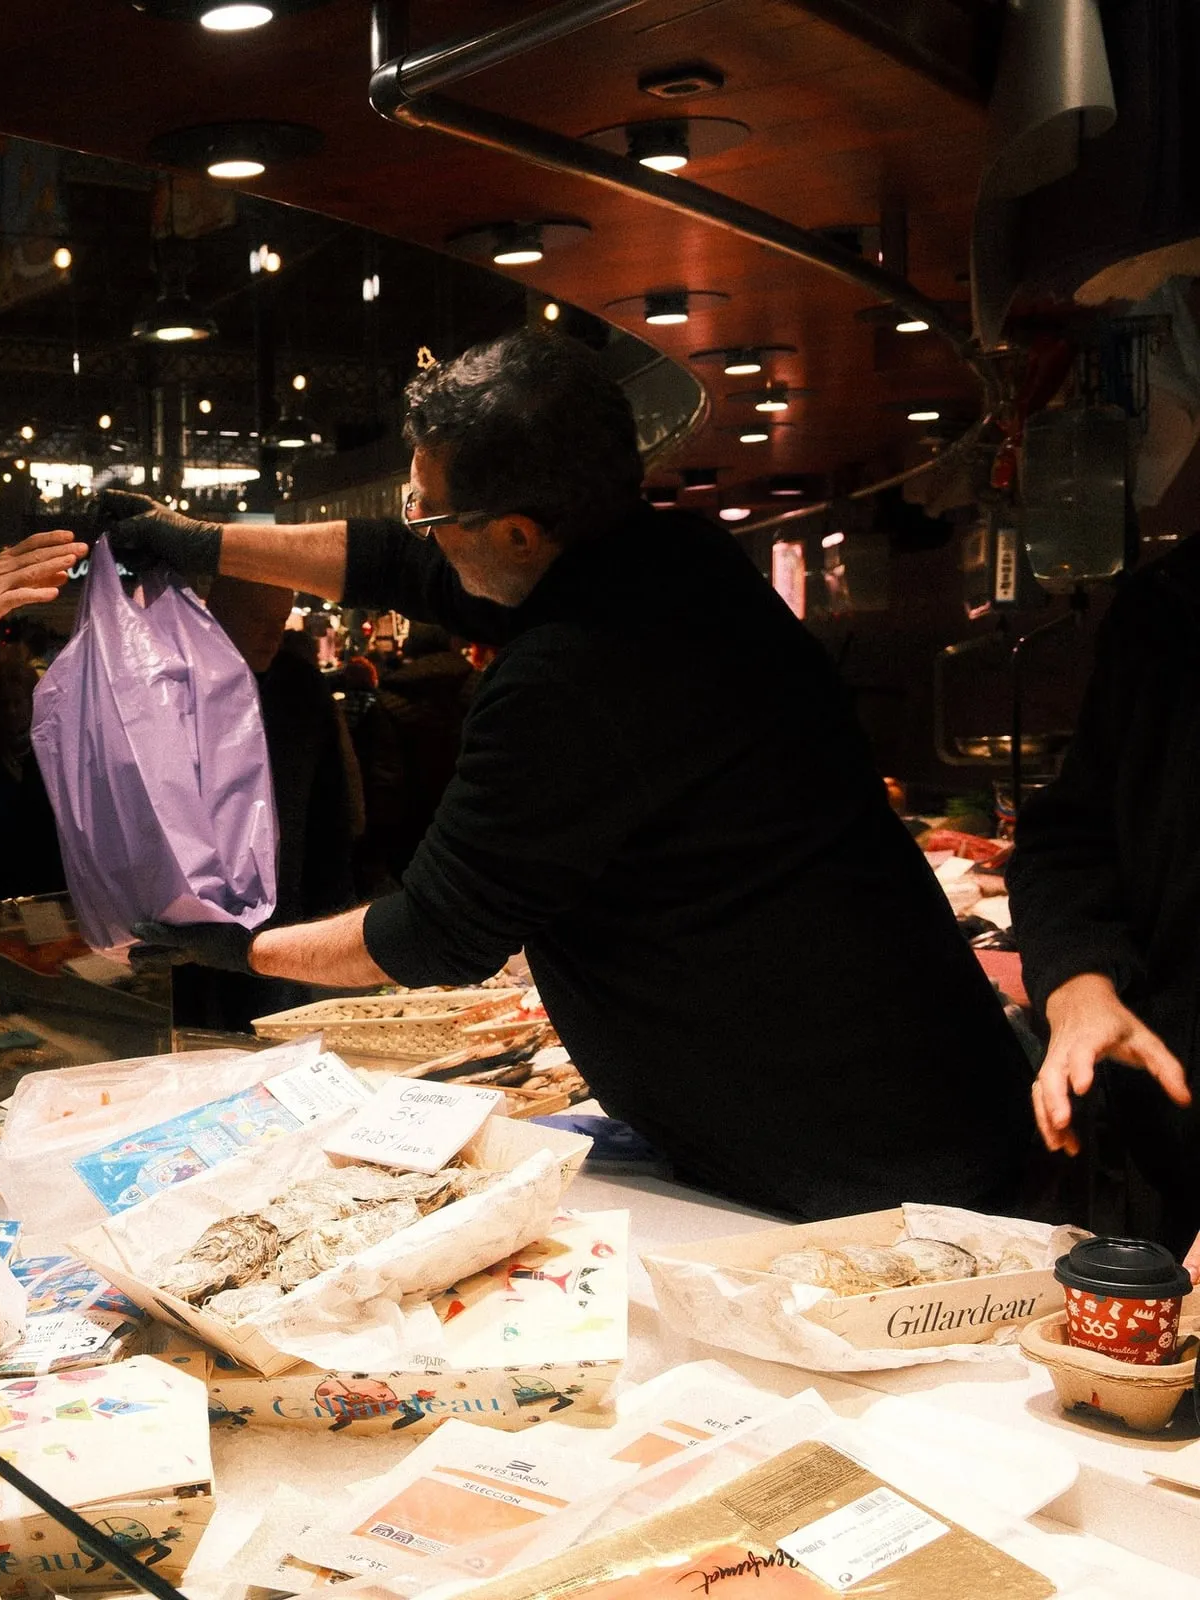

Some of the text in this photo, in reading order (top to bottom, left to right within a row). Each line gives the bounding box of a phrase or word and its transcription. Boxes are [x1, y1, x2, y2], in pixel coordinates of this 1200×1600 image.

[886, 1293, 1038, 1339] Gillardeau
[1080, 1315, 1119, 1340] 365
[272, 1393, 501, 1420] Gillardeau
[475, 1463, 507, 1475] REYES
